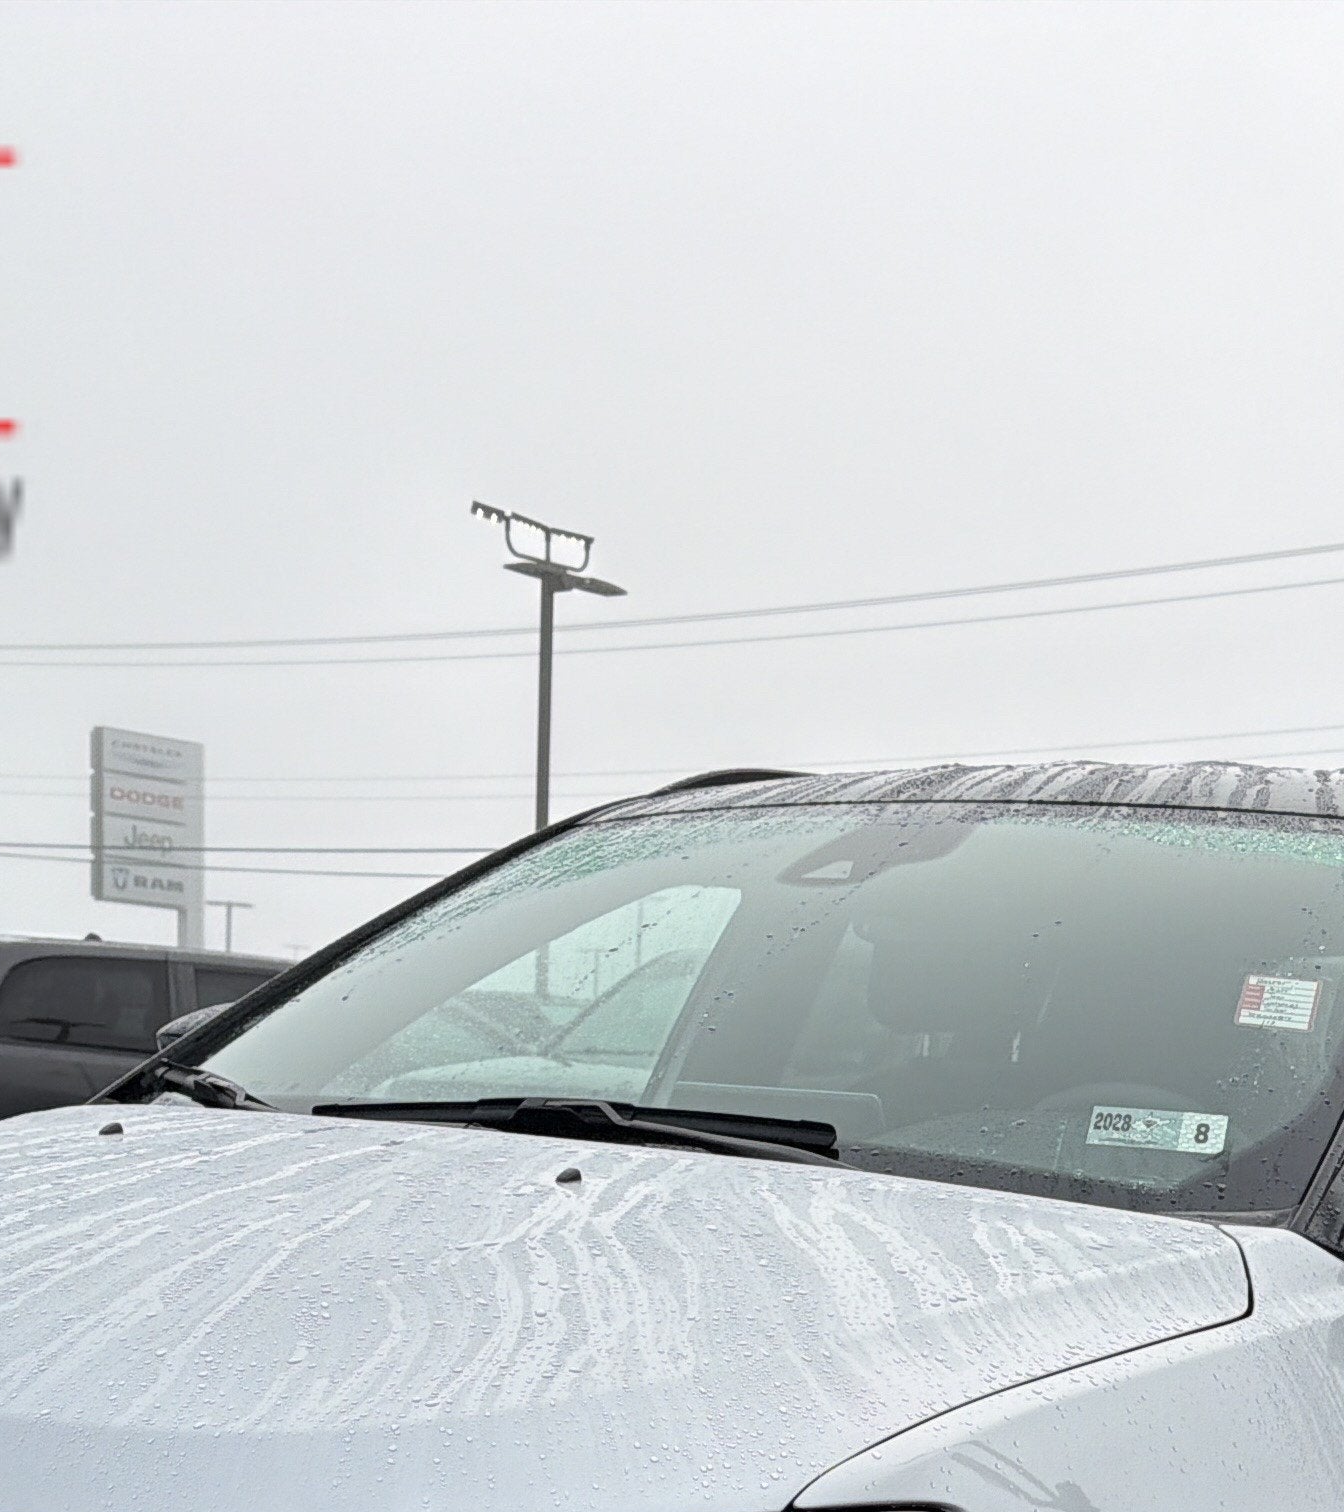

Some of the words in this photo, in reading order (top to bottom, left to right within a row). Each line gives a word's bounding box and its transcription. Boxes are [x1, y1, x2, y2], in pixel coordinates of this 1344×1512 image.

[110, 787, 184, 810] DODGE
[124, 824, 173, 857] Jeep
[133, 873, 184, 893] RAM
[1093, 1112, 1132, 1132] 2028
[1194, 1123, 1210, 1144] 8
